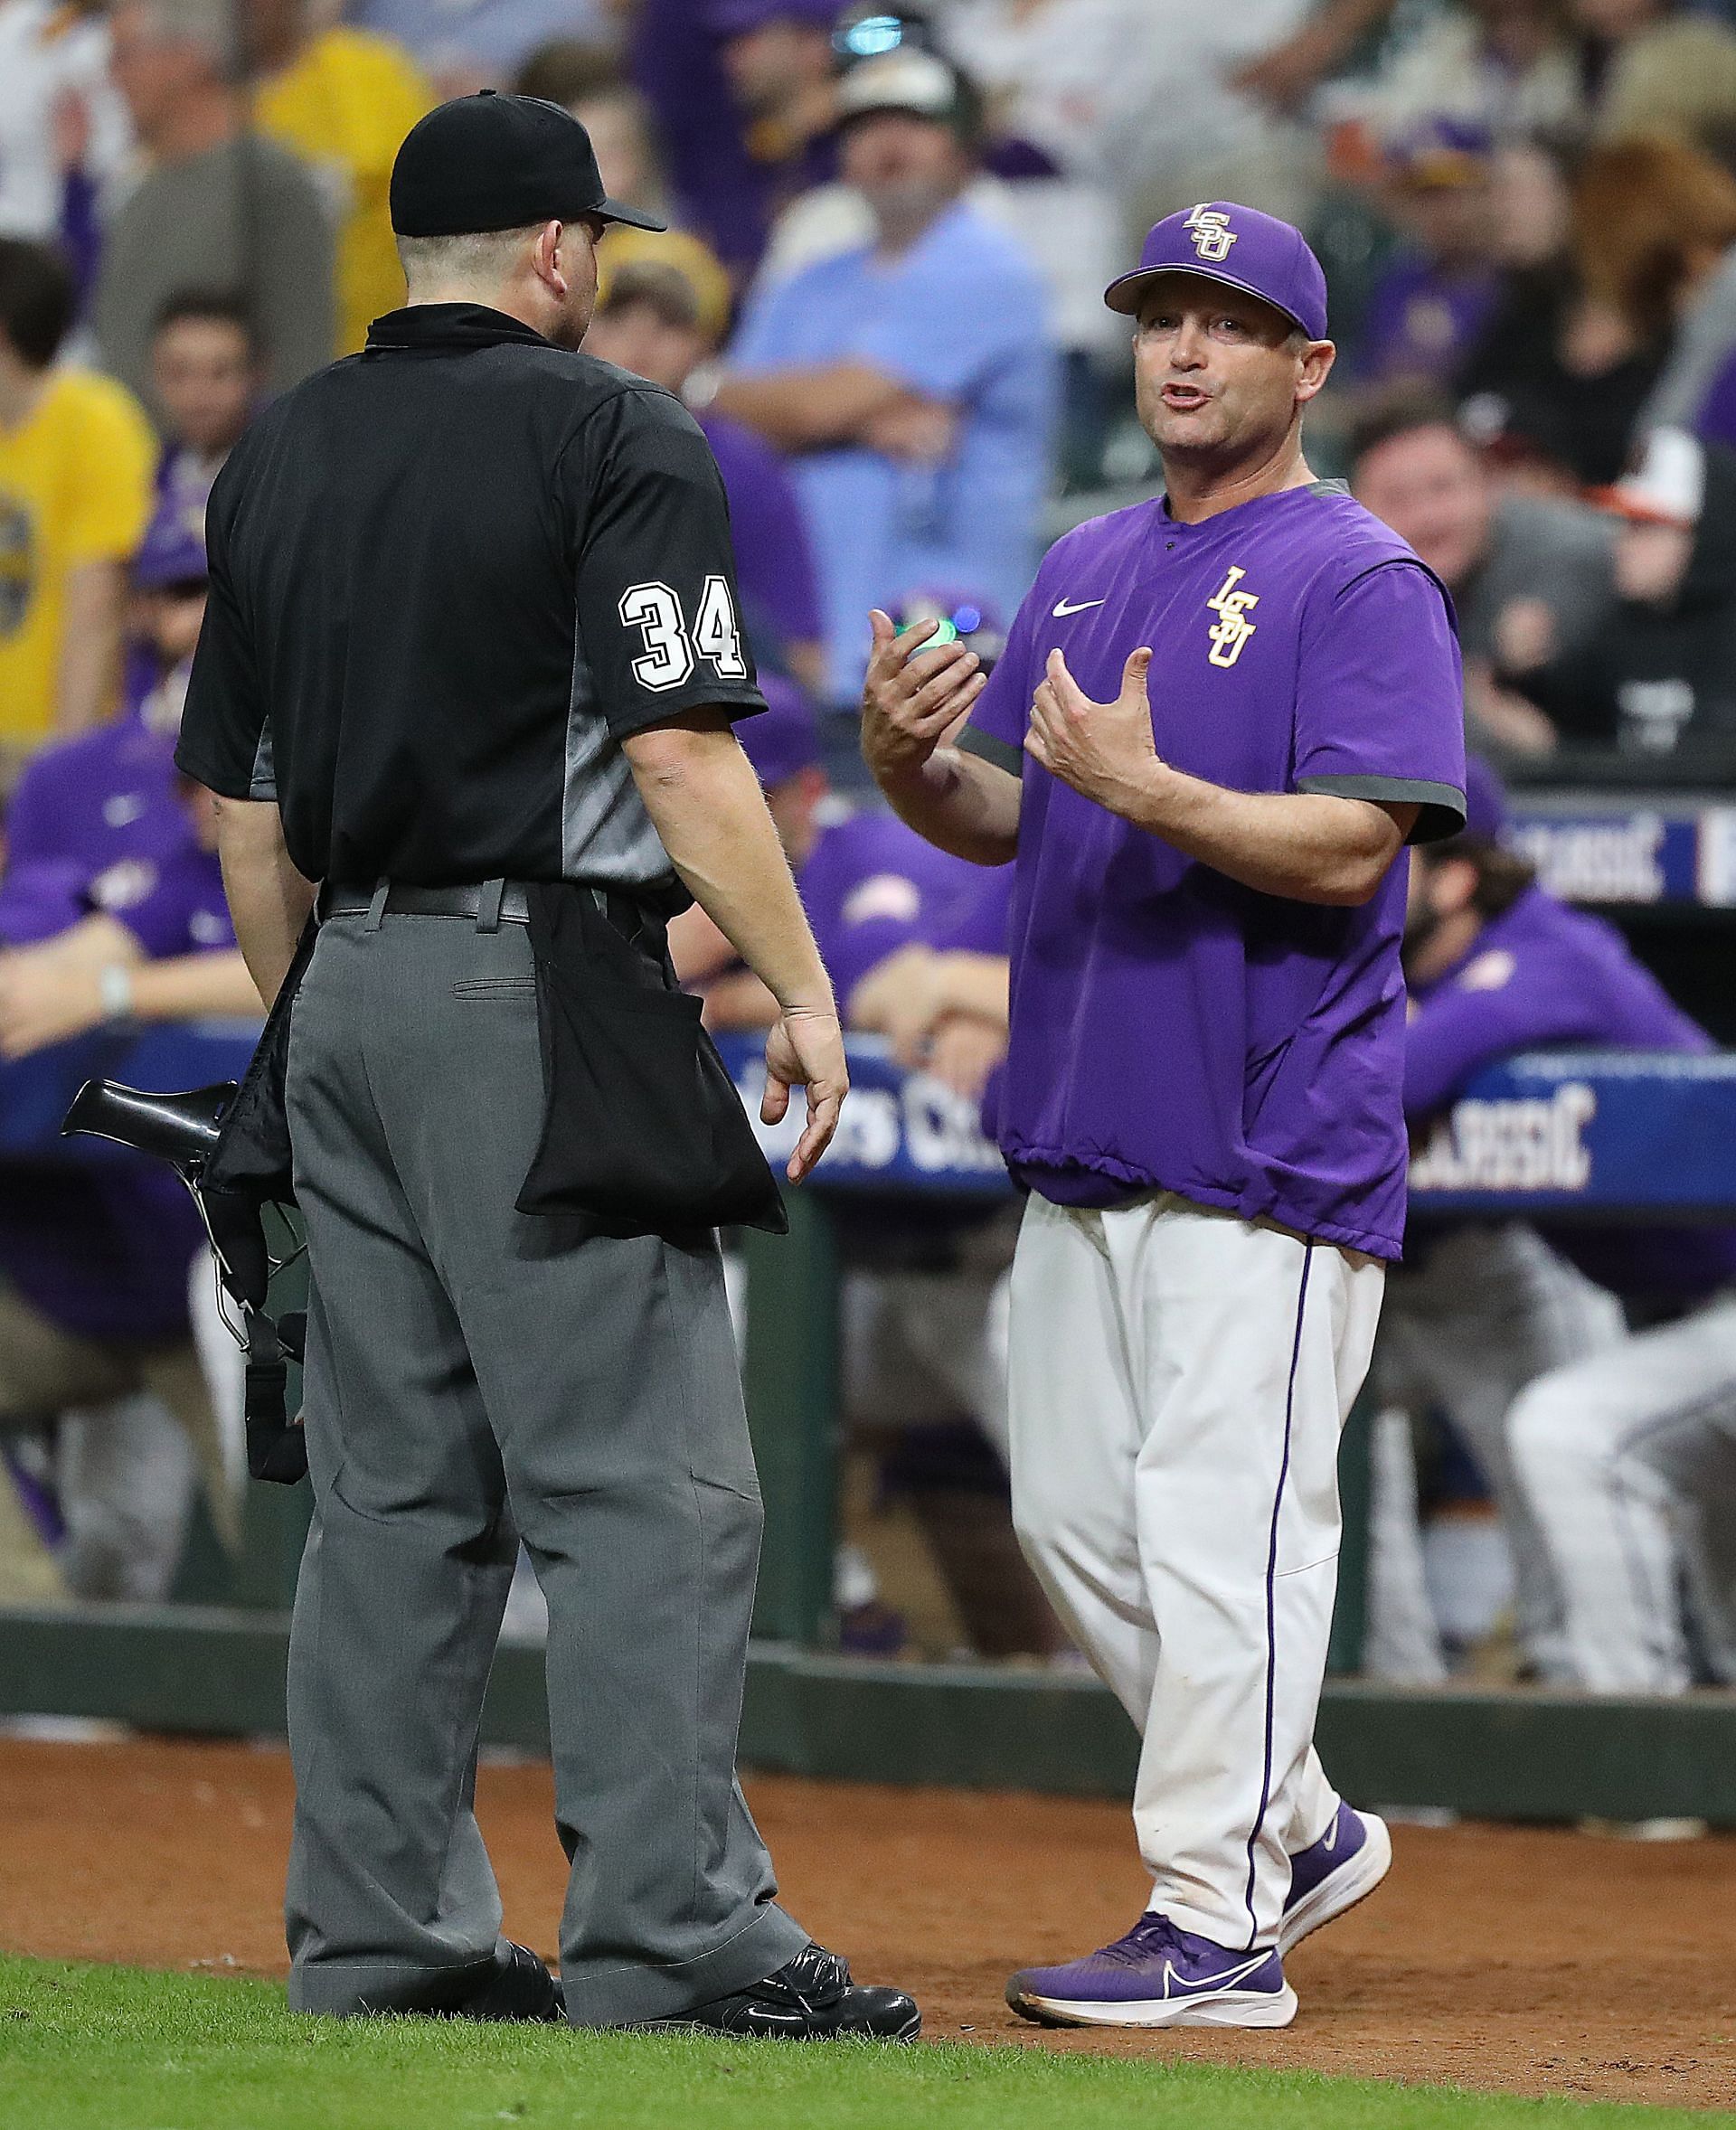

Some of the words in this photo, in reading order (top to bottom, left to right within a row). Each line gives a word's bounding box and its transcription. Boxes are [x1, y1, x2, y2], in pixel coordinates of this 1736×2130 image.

[1182, 203, 1238, 262] LSU
[618, 575, 747, 693] 34
[1206, 565, 1260, 669] LSU
